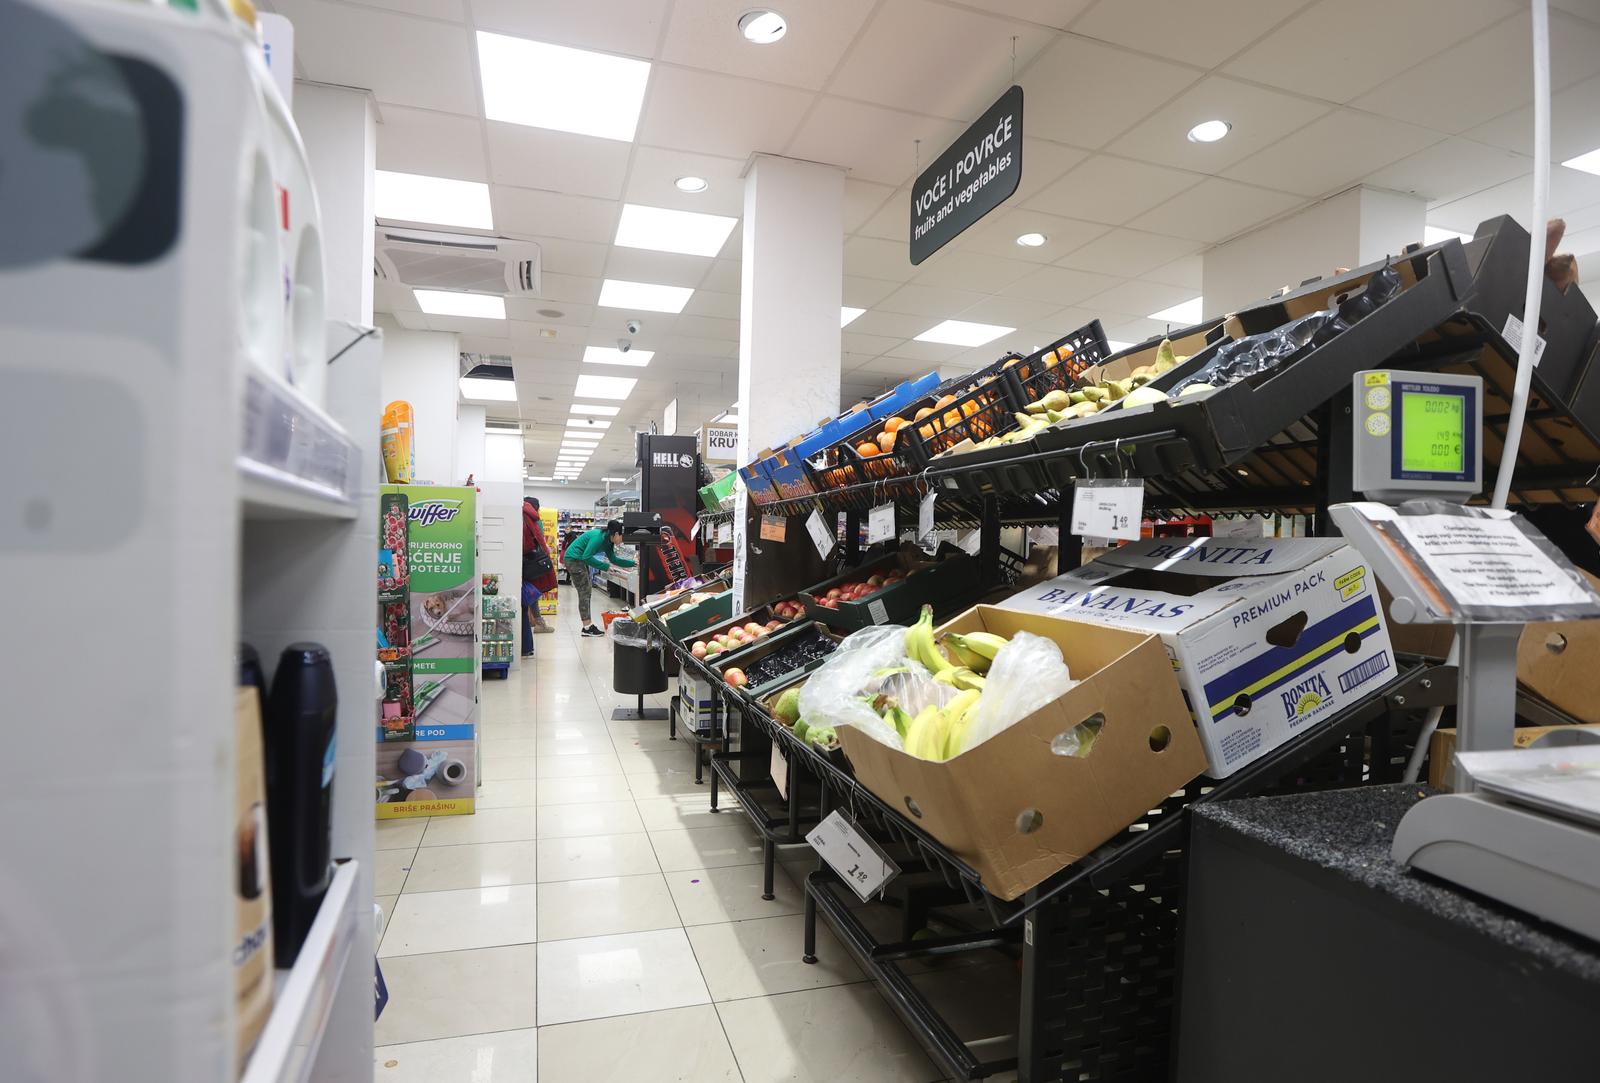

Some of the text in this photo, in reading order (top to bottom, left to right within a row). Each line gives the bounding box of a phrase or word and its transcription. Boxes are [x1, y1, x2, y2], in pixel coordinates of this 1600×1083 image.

[916, 114, 1013, 217] VOĆE I POVRĆE
[914, 151, 1012, 241] fruits and vegetables
[709, 438, 738, 448] KRU
[653, 452, 679, 465] HELL
[409, 503, 458, 526] wiffer
[1112, 515, 1119, 530] 1
[409, 542, 463, 550] RIJEKORNO
[1144, 545, 1273, 564] BONITA
[411, 565, 460, 573] POTEZU!
[1037, 588, 1194, 618] BANANAS
[1232, 590, 1292, 628] PREMIUM
[1294, 570, 1326, 596] PACK
[1280, 674, 1332, 719] BONITA
[393, 803, 456, 813] BRIŠE PRAŠINU
[848, 864, 859, 876] 1
